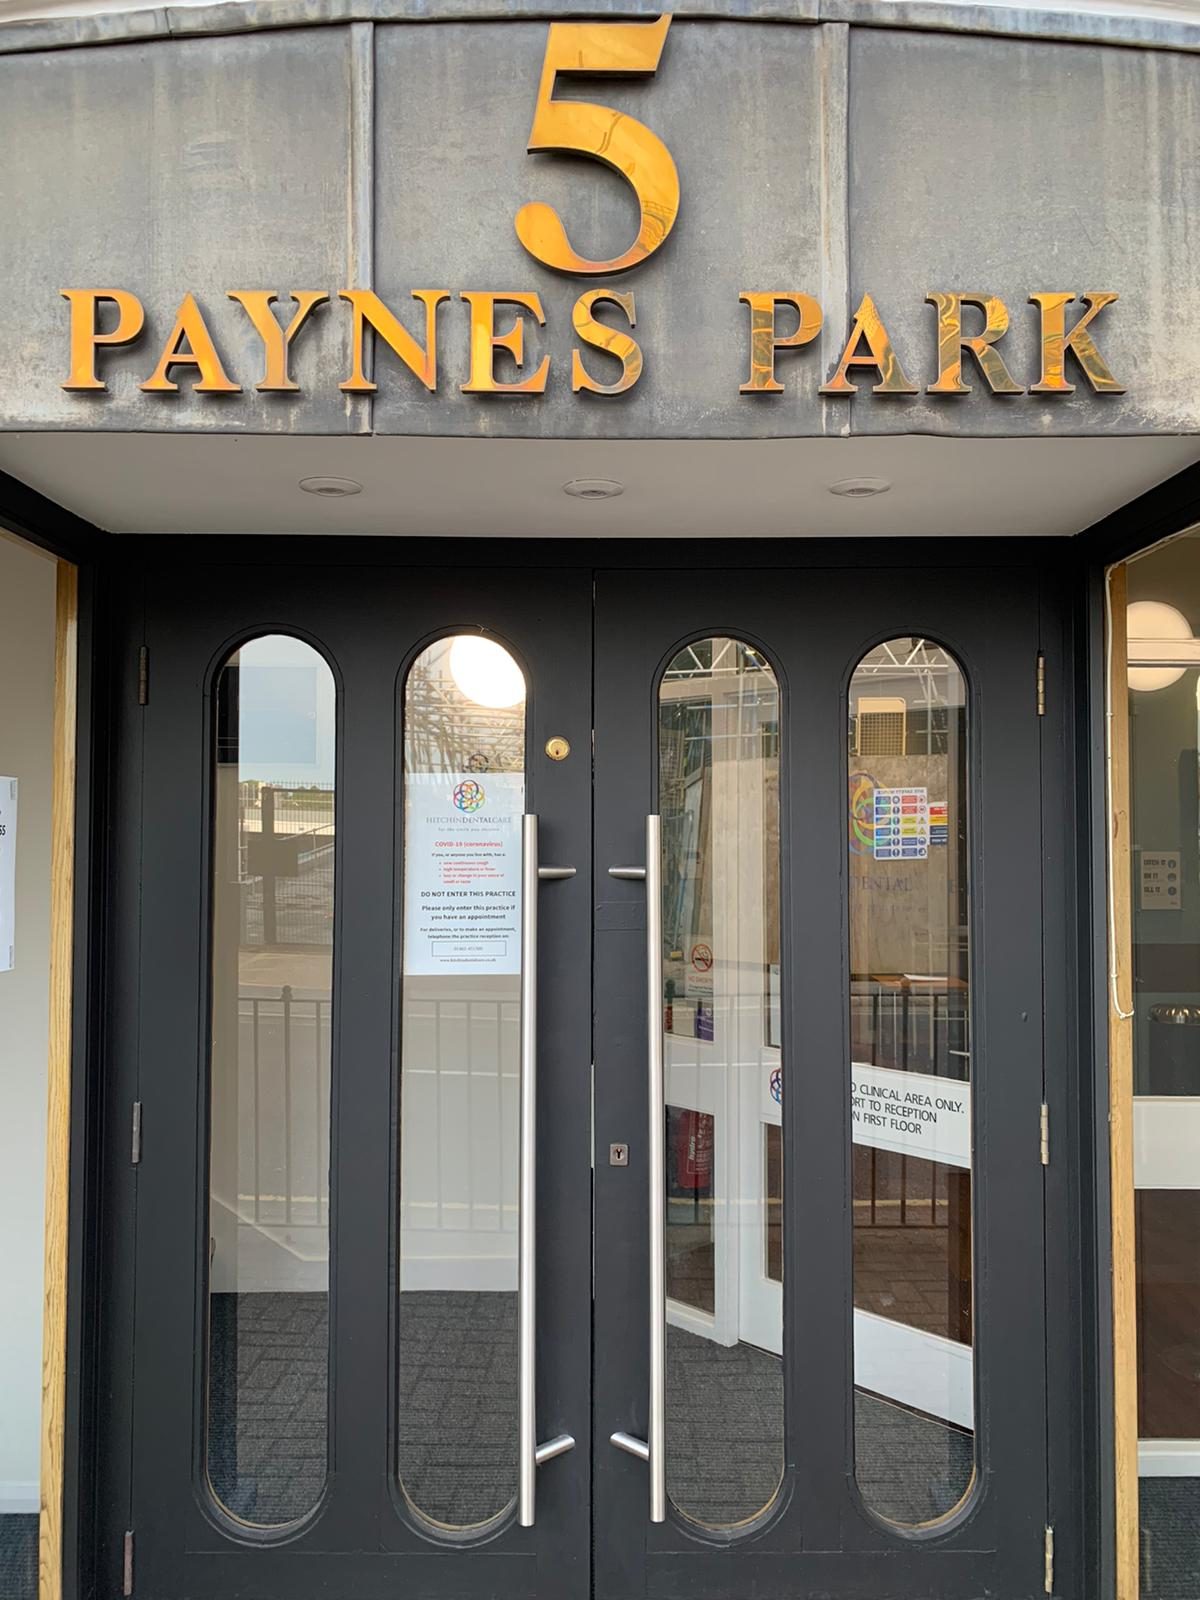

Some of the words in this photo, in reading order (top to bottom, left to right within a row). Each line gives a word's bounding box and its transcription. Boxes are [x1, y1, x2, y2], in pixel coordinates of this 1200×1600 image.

[514, 12, 680, 277] 5
[59, 287, 645, 395] PAYNES
[738, 291, 1127, 395] PARK
[860, 1084, 902, 1101] CLINICAL
[904, 1092, 932, 1107] AREA
[936, 1098, 964, 1114] ONLY.
[869, 1100, 881, 1112] TO
[884, 1103, 937, 1123] RECEPTION
[864, 1113, 887, 1127] FIRST
[890, 1118, 922, 1134] FLOOR
